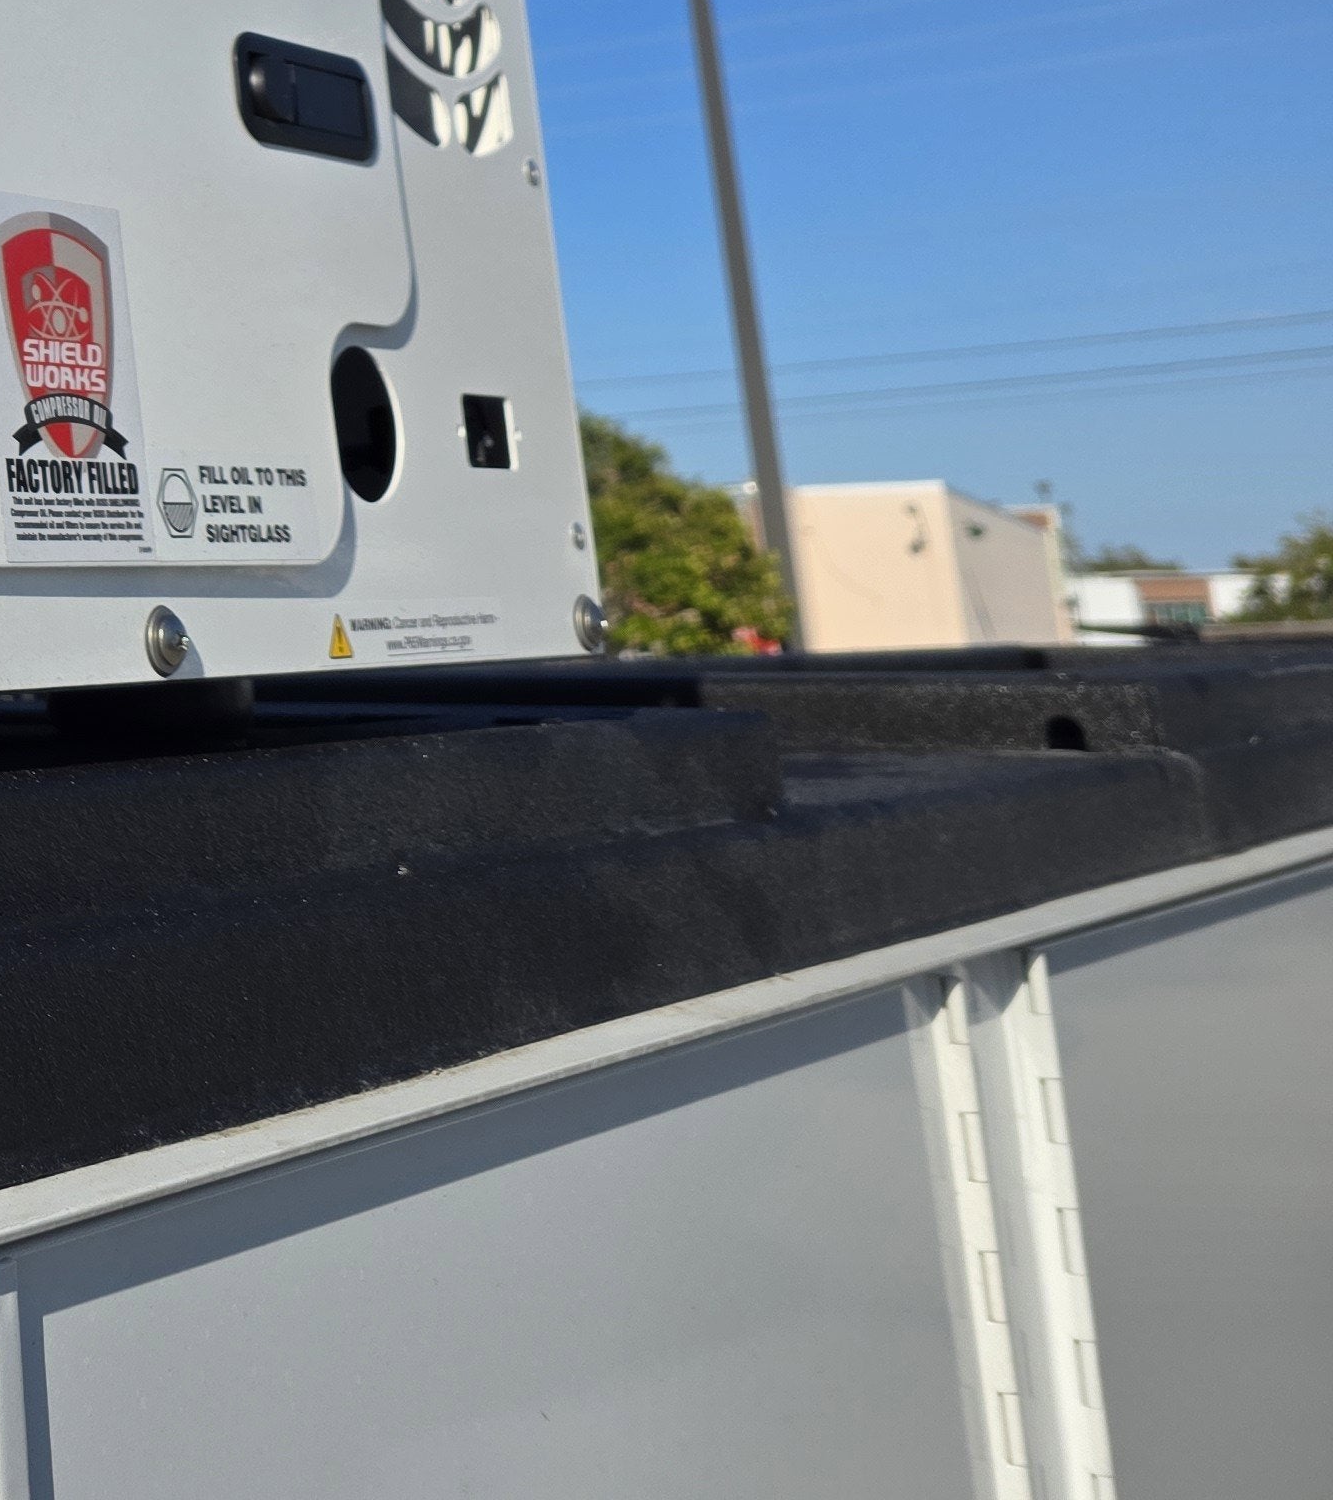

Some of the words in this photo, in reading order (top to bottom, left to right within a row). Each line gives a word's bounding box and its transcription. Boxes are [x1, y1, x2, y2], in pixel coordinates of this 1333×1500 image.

[23, 338, 102, 367] SHIELD
[26, 364, 106, 392] WORKS
[30, 395, 91, 424] COMPRESSOR
[5, 457, 83, 493] FACTORY
[86, 461, 140, 495] FILLED
[199, 465, 229, 484] FILL
[230, 466, 253, 485] OIL
[255, 467, 274, 486] TO
[276, 468, 308, 487] THIS
[202, 494, 246, 513] LEVEL
[247, 495, 263, 514] IN
[206, 523, 292, 543] SIGHTGLASS
